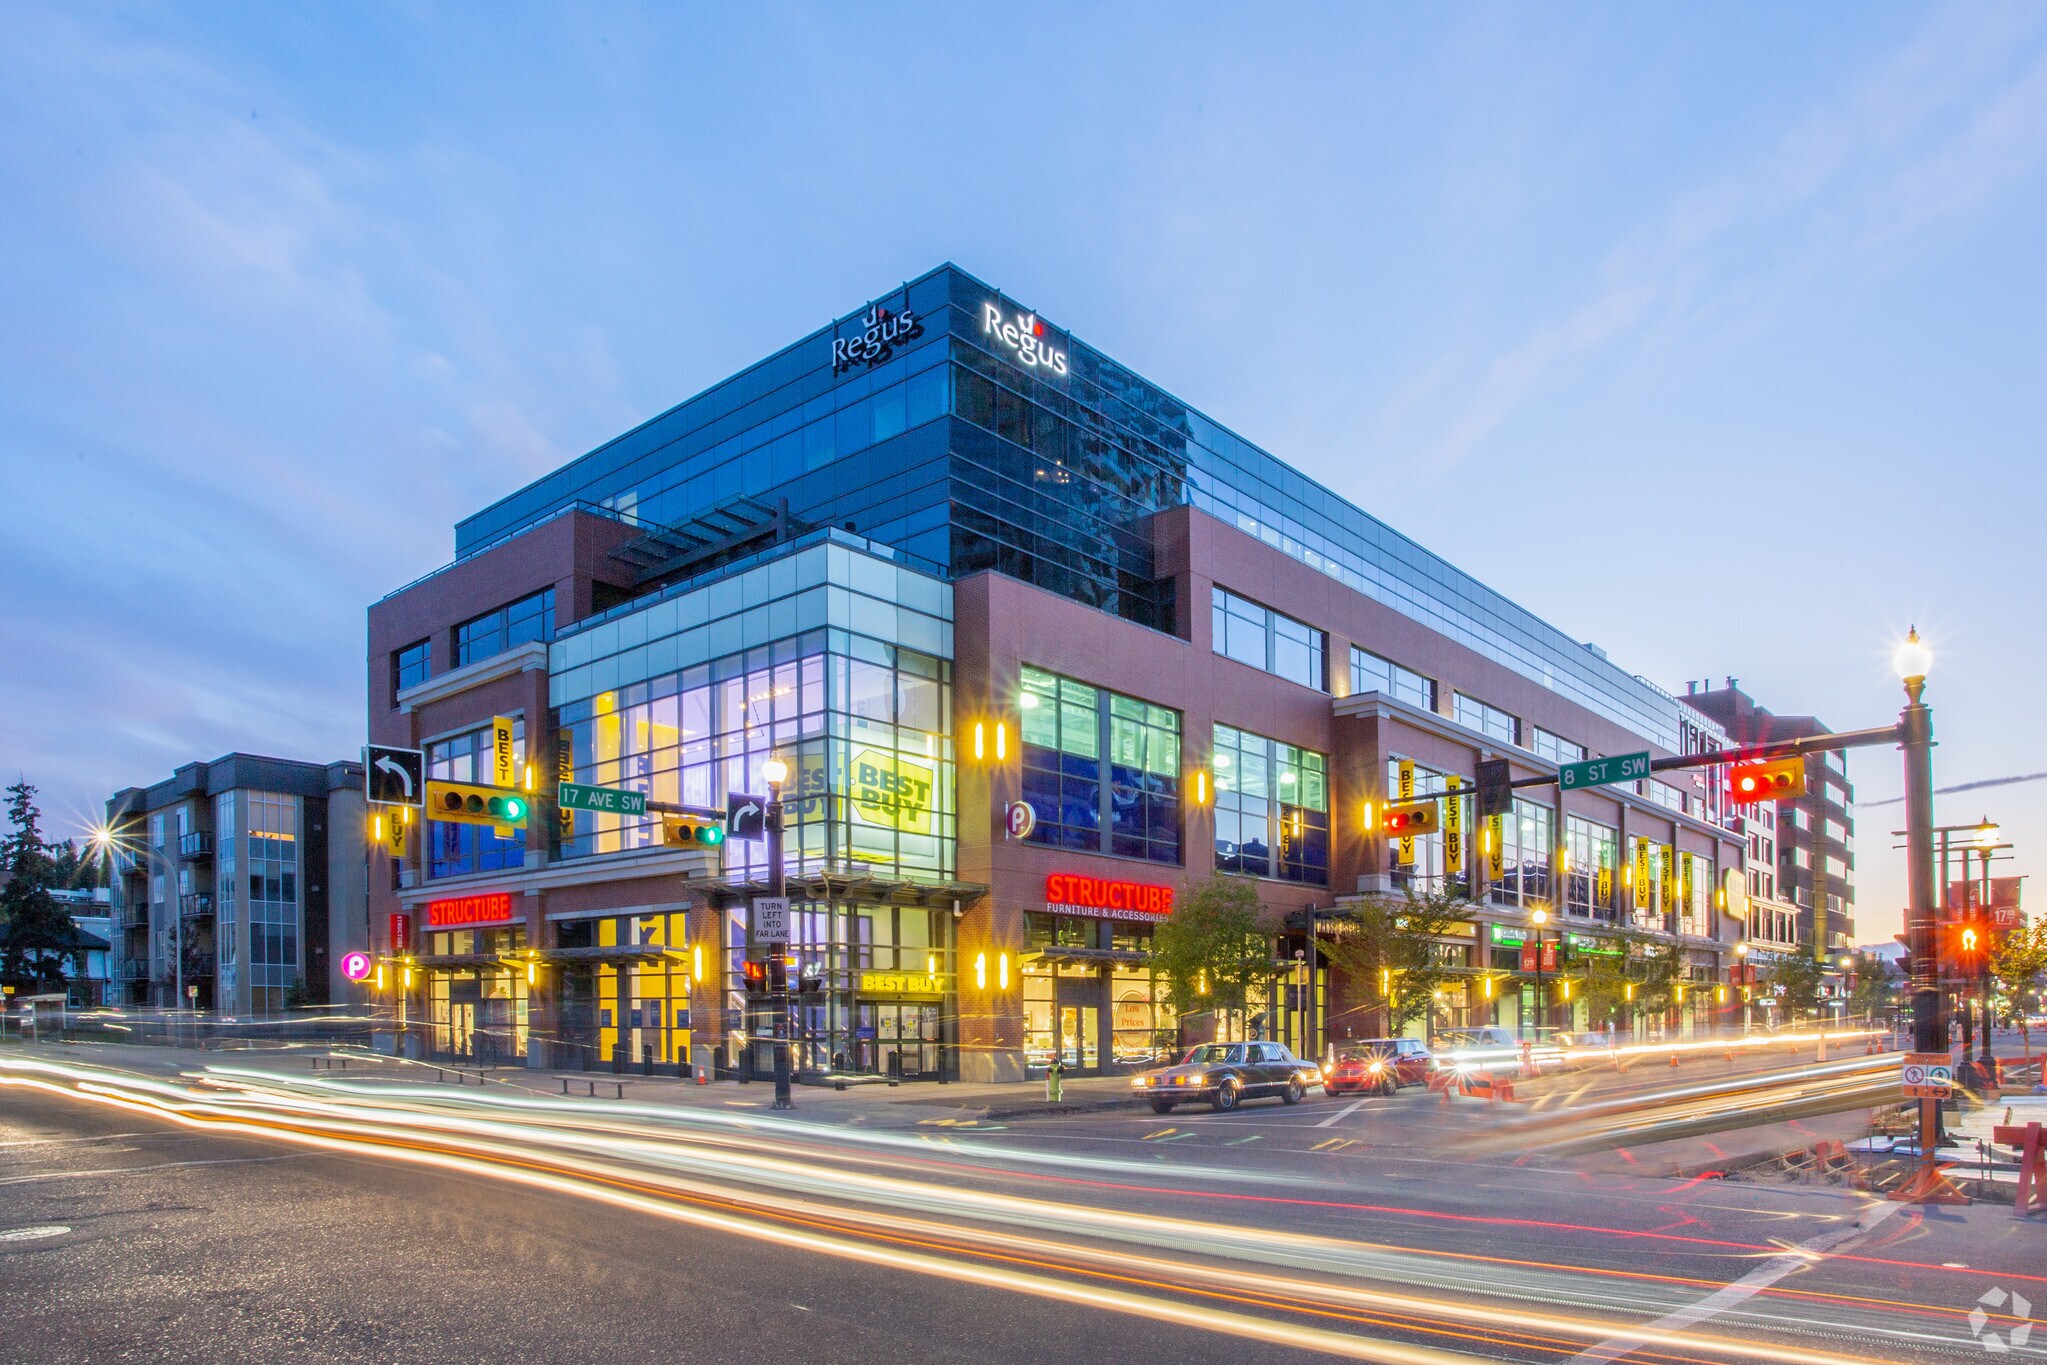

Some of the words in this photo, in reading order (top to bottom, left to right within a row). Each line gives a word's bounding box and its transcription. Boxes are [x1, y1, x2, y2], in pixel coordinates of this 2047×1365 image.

[832, 309, 912, 367] Regus
[985, 303, 1067, 374] Regus
[497, 728, 510, 781] BEST
[859, 762, 930, 802] BEST
[1564, 769, 1575, 785] 8
[1588, 764, 1609, 781] ST
[1621, 758, 1646, 776] SW
[563, 788, 579, 803] 17
[588, 791, 614, 808] AVE
[621, 796, 642, 810] SW
[860, 787, 925, 822] BUY
[391, 813, 403, 848] BUY
[1012, 806, 1025, 832] P
[1448, 833, 1458, 863] BUY
[1638, 843, 1646, 875] BEST
[1662, 851, 1670, 881] BEST
[1049, 875, 1173, 913] STRUCTUBE
[1638, 878, 1646, 902] BUY
[1662, 885, 1670, 907] BUY
[431, 896, 509, 925] STRUCTUBE
[760, 902, 783, 910] TURN
[762, 911, 782, 919] LEFT
[1046, 903, 1099, 917] FURNITURE
[1102, 908, 1109, 917] &
[1111, 909, 1169, 923] ACCESSORIES
[755, 930, 769, 938] FAR
[770, 930, 789, 938] LANE
[763, 920, 782, 928] INTO
[349, 955, 364, 976] P
[862, 975, 906, 991] BEST
[907, 977, 945, 992] BUY
[1125, 1004, 1140, 1013] Low
[1121, 1018, 1145, 1027] Prices
